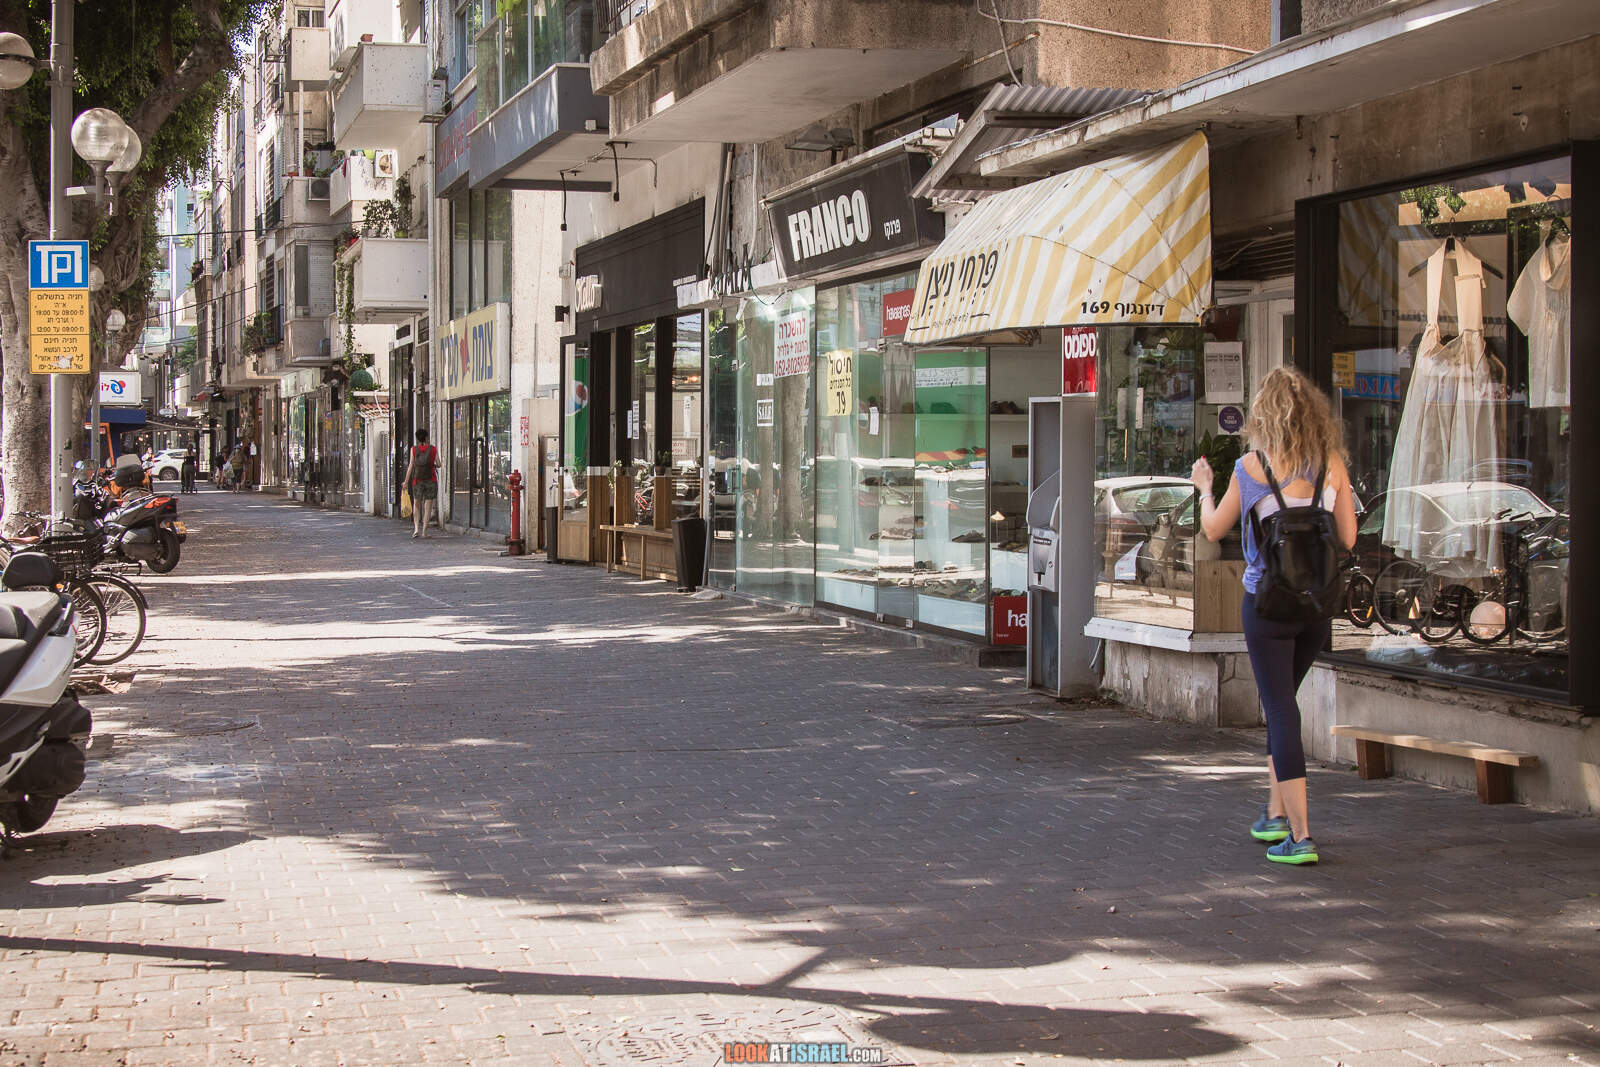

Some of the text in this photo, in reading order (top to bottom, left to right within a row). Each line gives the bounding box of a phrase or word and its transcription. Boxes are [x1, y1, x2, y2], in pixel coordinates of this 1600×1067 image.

[788, 189, 871, 261] FRANCO
[1081, 301, 1165, 317] דיזנגוף 169
[472, 320, 494, 383] צומת
[829, 354, 852, 375] חיסול
